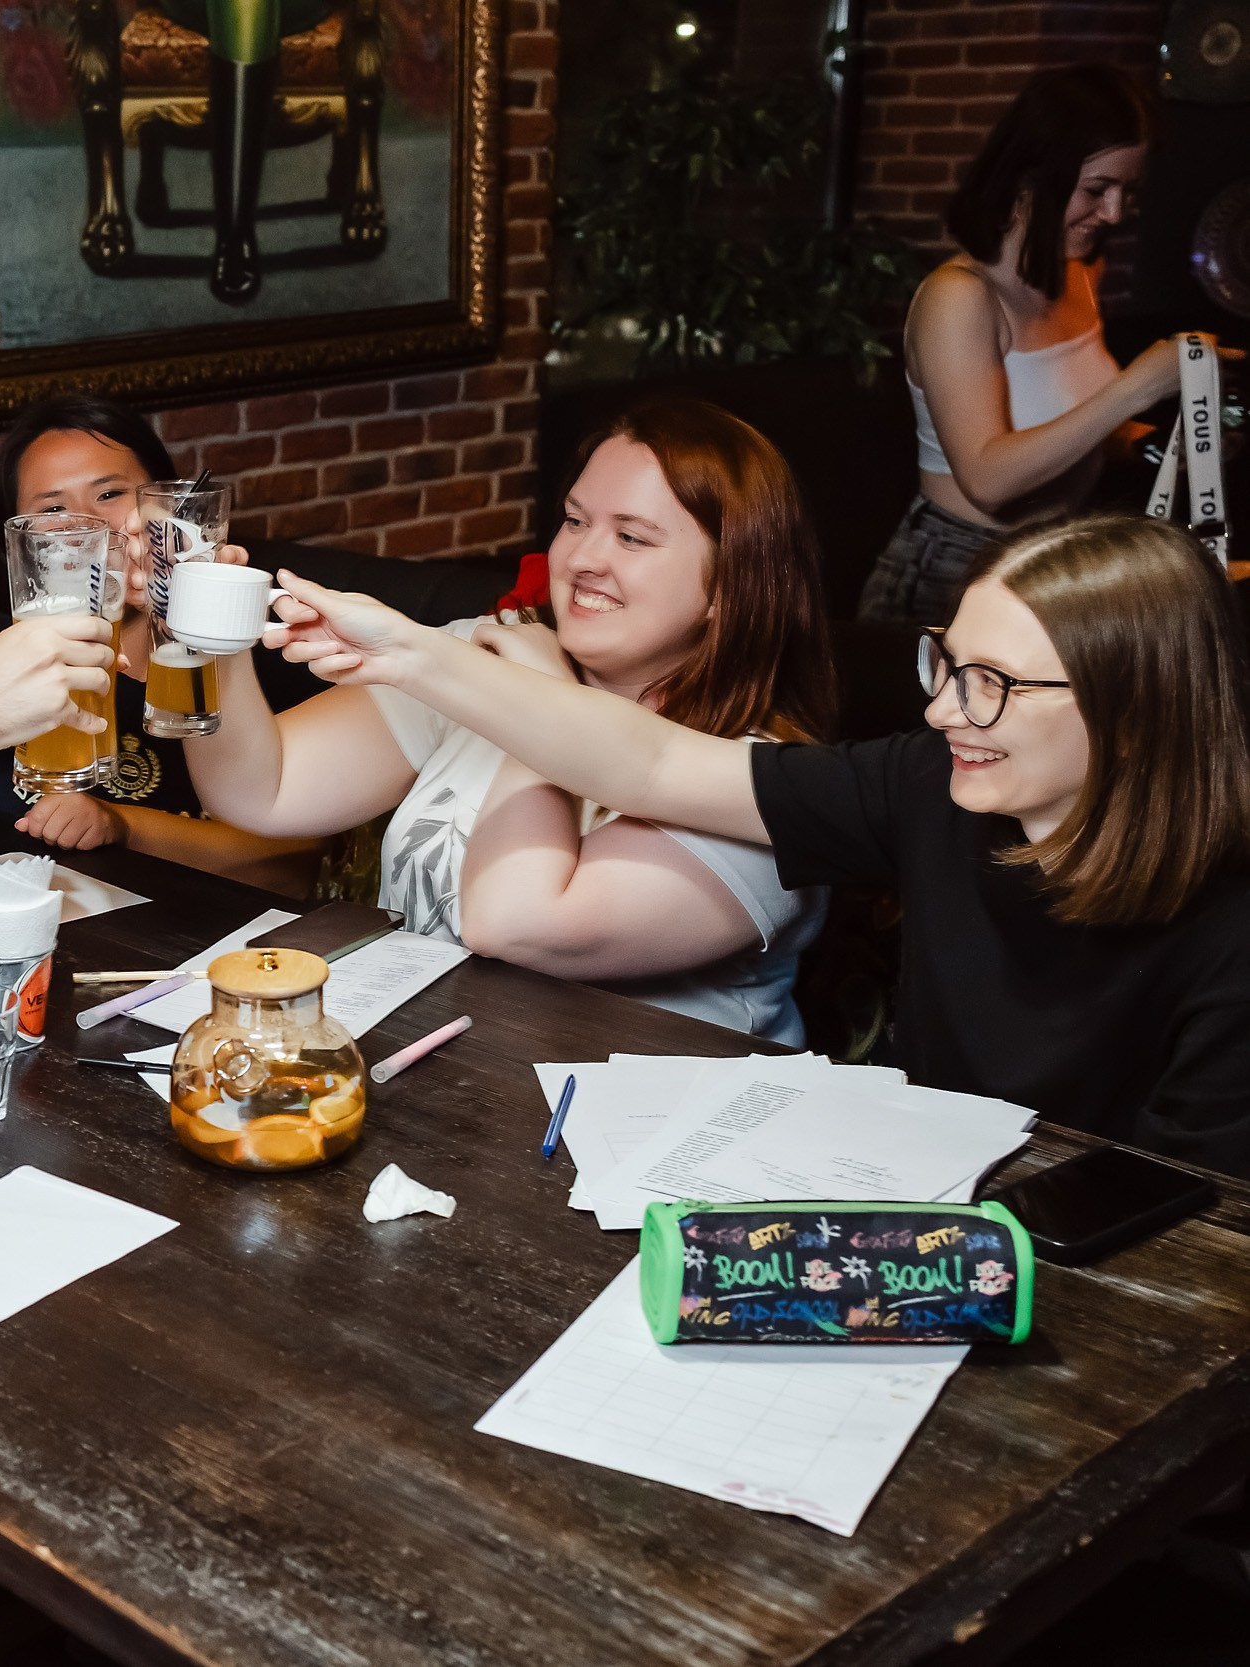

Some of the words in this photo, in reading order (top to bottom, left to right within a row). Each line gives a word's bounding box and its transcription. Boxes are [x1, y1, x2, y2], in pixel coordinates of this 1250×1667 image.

[1186, 335, 1204, 361] US
[1192, 395, 1211, 454] TOUS
[1154, 492, 1170, 517] TO
[1199, 488, 1218, 523] TO
[712, 1251, 795, 1290] BOOM!
[877, 1254, 963, 1295] BOOM!
[680, 1308, 731, 1326] ING
